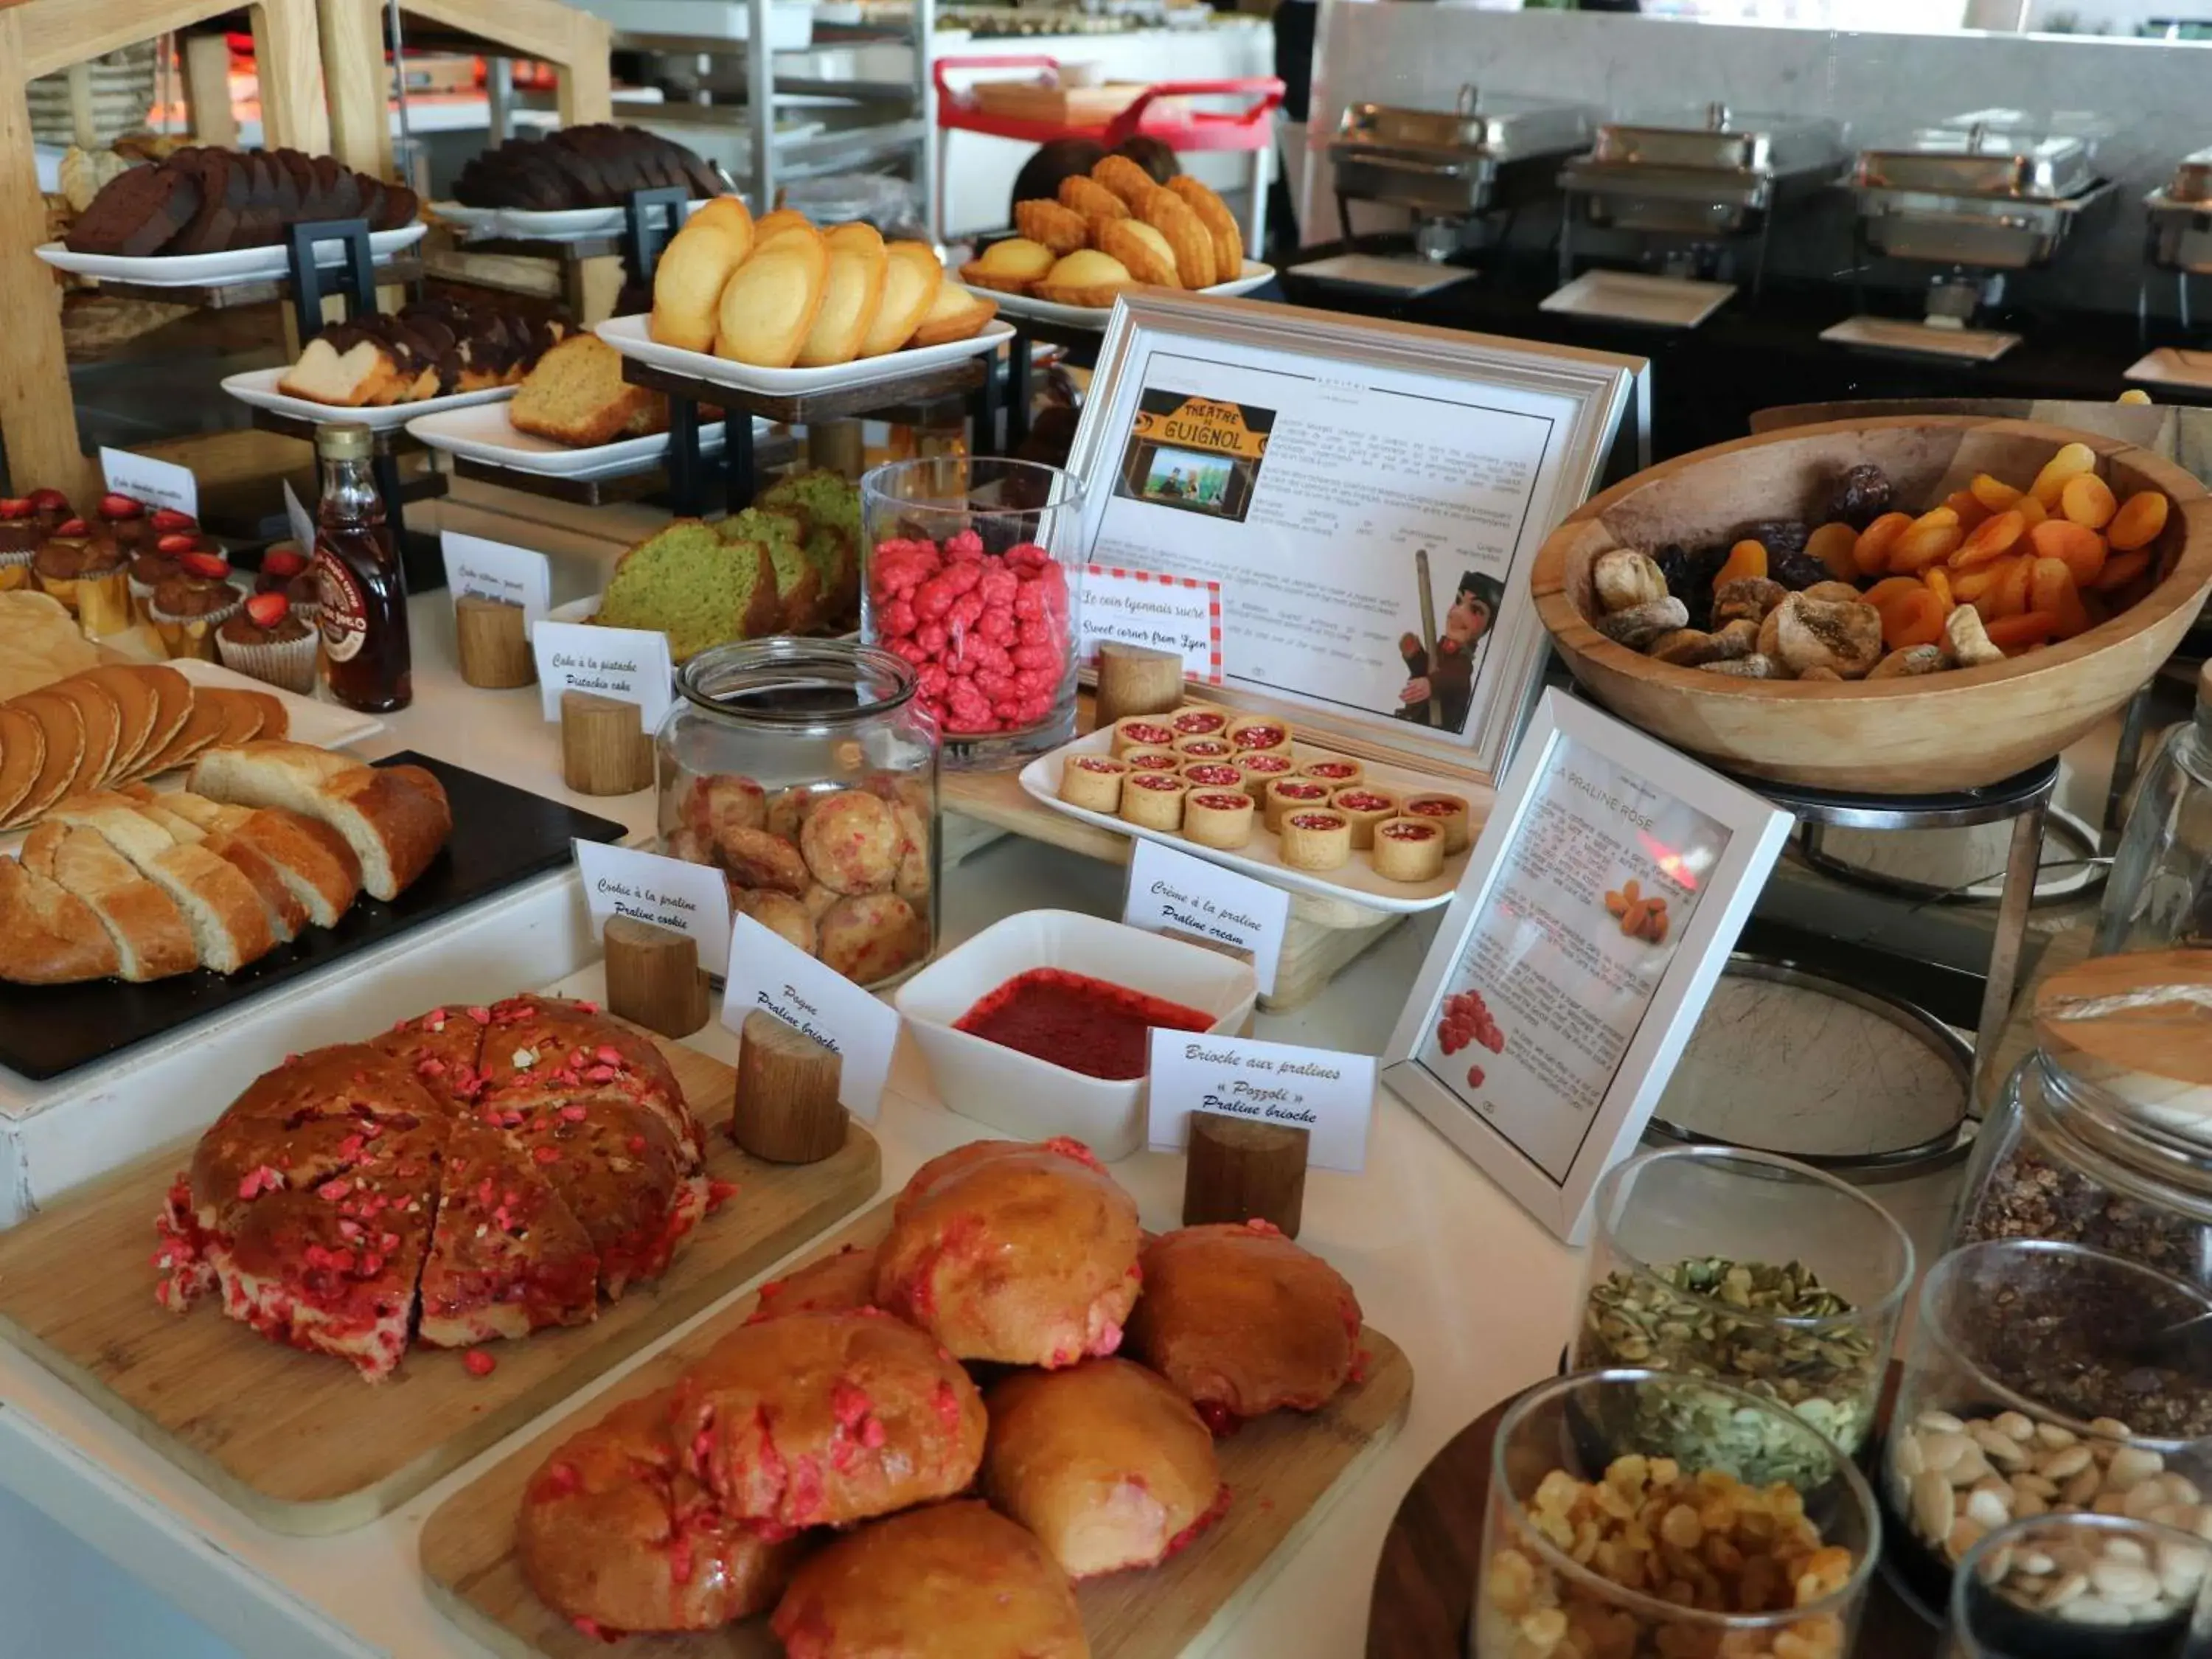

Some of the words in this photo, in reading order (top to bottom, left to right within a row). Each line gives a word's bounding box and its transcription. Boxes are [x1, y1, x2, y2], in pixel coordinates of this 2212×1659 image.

[1165, 421, 1243, 451] GUIGNOL
[1082, 590, 1095, 605] Le
[1099, 597, 1121, 609] coin
[1124, 597, 1172, 615] lyonnais
[1082, 619, 1113, 636] Sweet
[1116, 627, 1148, 641] corner
[1152, 630, 1178, 646] from
[1180, 633, 1207, 653] Lyon
[552, 653, 575, 668] Cake
[588, 657, 597, 669] la
[600, 660, 637, 673] pistache
[611, 680, 631, 692] cake
[1568, 772, 1618, 812] PRALINE
[1620, 804, 1654, 832] ROSE
[598, 877, 631, 897] Cookie
[634, 886, 641, 899] à
[645, 889, 655, 901] la
[659, 895, 698, 911] praline
[1151, 880, 1188, 902] Crème
[1191, 896, 1200, 908] à
[1203, 900, 1215, 914] la
[1217, 908, 1262, 931] praline
[614, 901, 654, 922] Praline
[657, 915, 688, 929] cookie
[1162, 904, 1206, 931] Praline
[1209, 928, 1244, 945] cream
[783, 984, 818, 1016] Pogne
[757, 990, 800, 1027] Praline
[801, 1022, 841, 1053] brioche
[1185, 1043, 1242, 1066] Brioche
[1246, 1057, 1273, 1070] aux
[1276, 1062, 1341, 1079] pralines
[1233, 1080, 1289, 1102] Pozzoli
[1203, 1094, 1262, 1116] Praline
[1265, 1105, 1318, 1124] brioche
